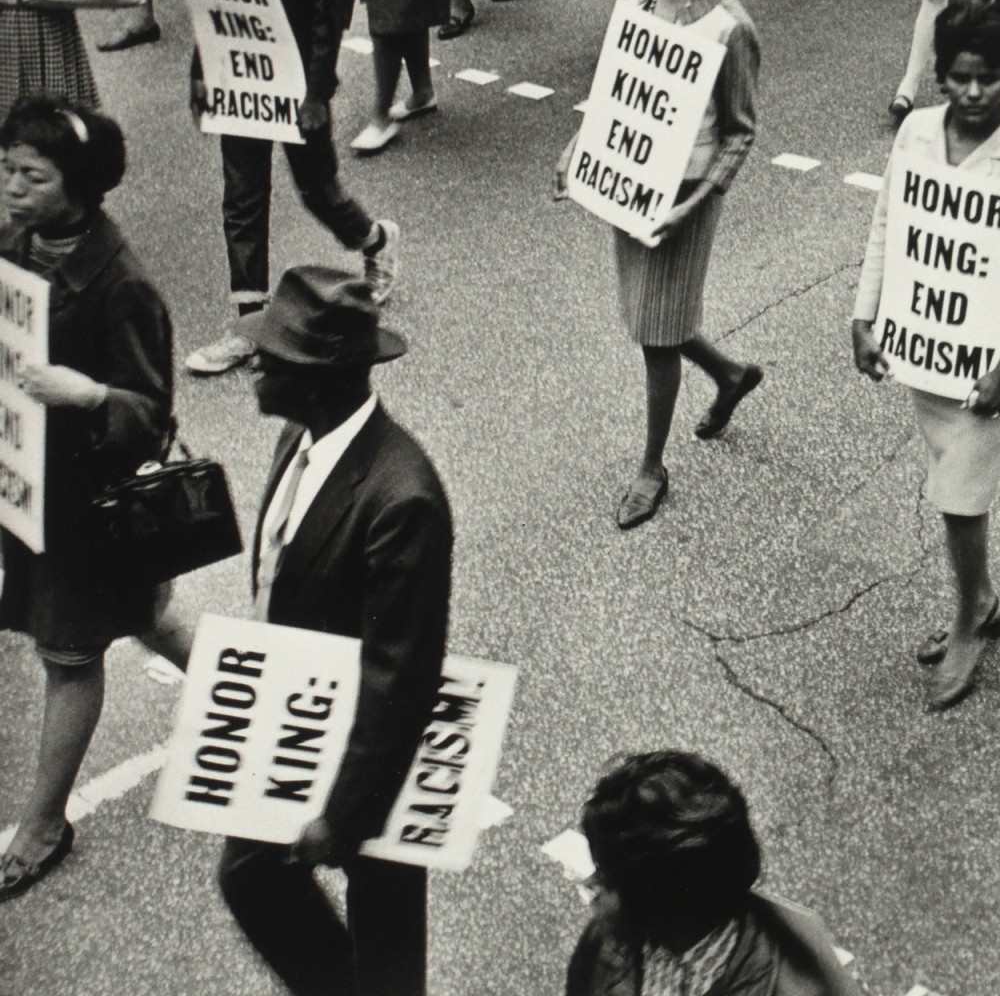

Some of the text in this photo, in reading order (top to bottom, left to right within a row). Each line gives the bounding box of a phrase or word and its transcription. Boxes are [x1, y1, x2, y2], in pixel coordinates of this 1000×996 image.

[208, 9, 276, 44] KING:
[616, 19, 704, 84] HONOR
[229, 49, 275, 82] END
[209, 87, 300, 126] RACISM!
[610, 68, 678, 127] KING:
[606, 118, 654, 166] END
[574, 150, 665, 222] RACISM!
[905, 224, 990, 279] KING:
[910, 280, 969, 326] END
[880, 317, 996, 382] RACISM!
[184, 646, 268, 808] HONOR
[263, 676, 339, 804] KING:
[399, 675, 486, 848] RACISM!
